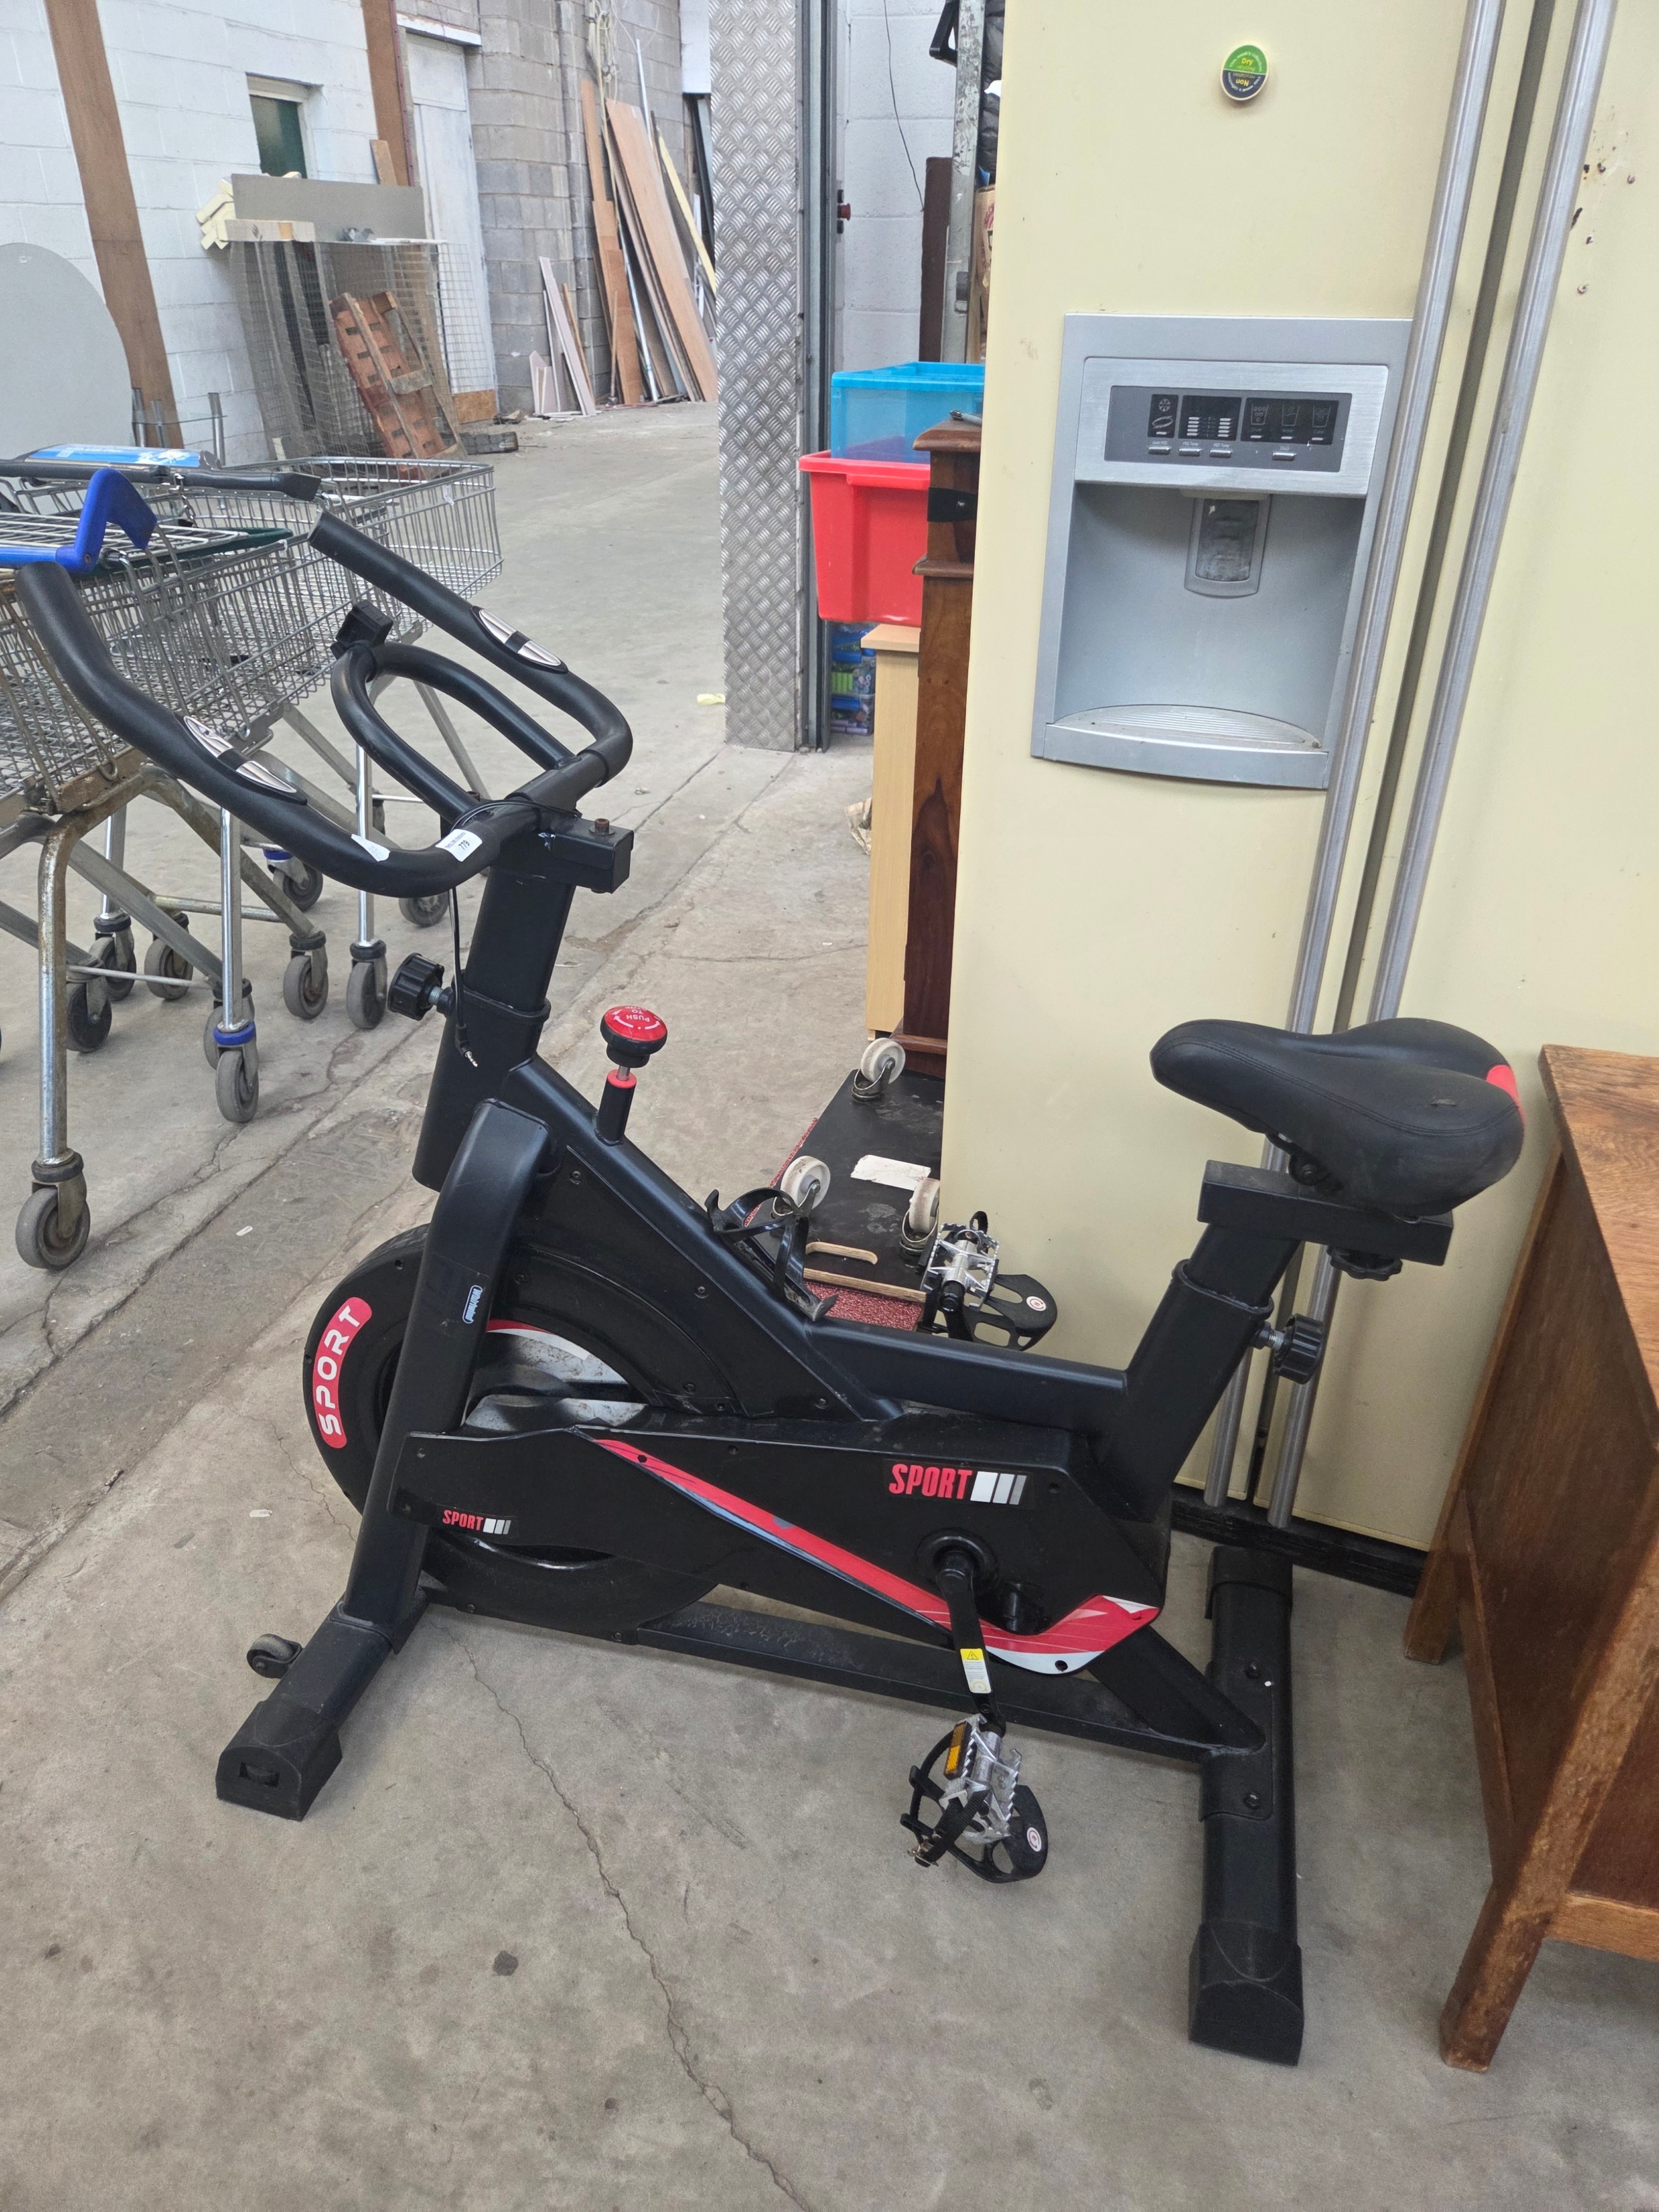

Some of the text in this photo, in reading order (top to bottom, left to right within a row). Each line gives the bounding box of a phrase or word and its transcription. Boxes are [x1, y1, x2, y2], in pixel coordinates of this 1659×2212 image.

[458, 840, 470, 850] 779
[316, 1305, 360, 1436] SPORT
[889, 1463, 973, 1499] SPORT
[442, 1509, 484, 1530] SPORT
